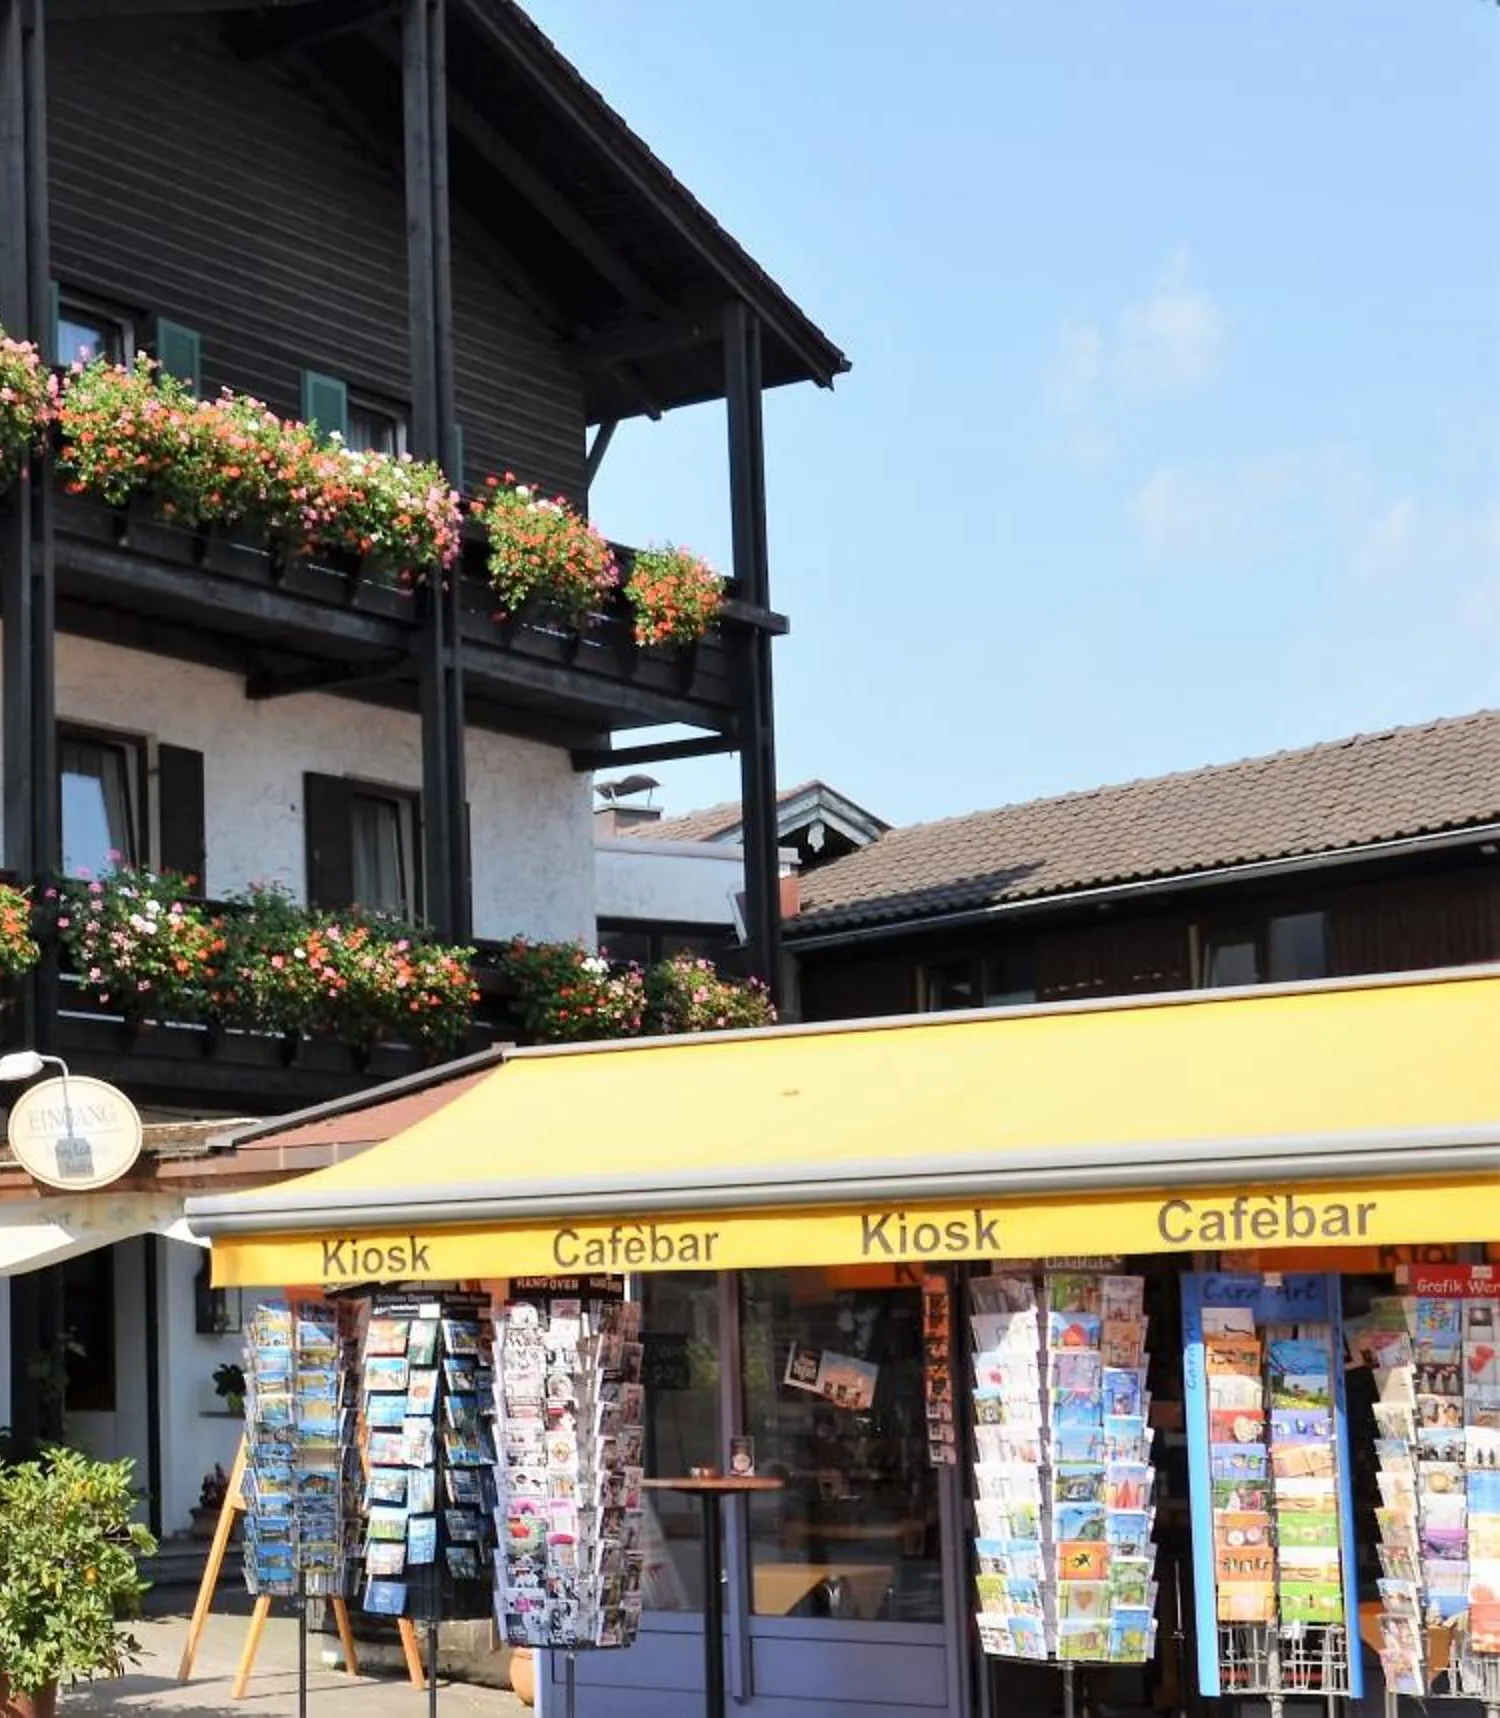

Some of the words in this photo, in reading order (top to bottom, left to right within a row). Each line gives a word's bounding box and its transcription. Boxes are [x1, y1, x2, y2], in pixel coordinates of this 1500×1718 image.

[859, 1208, 1003, 1257] Kiosk
[321, 1234, 432, 1277] Kiosk
[1417, 1279, 1463, 1294] Grafik
